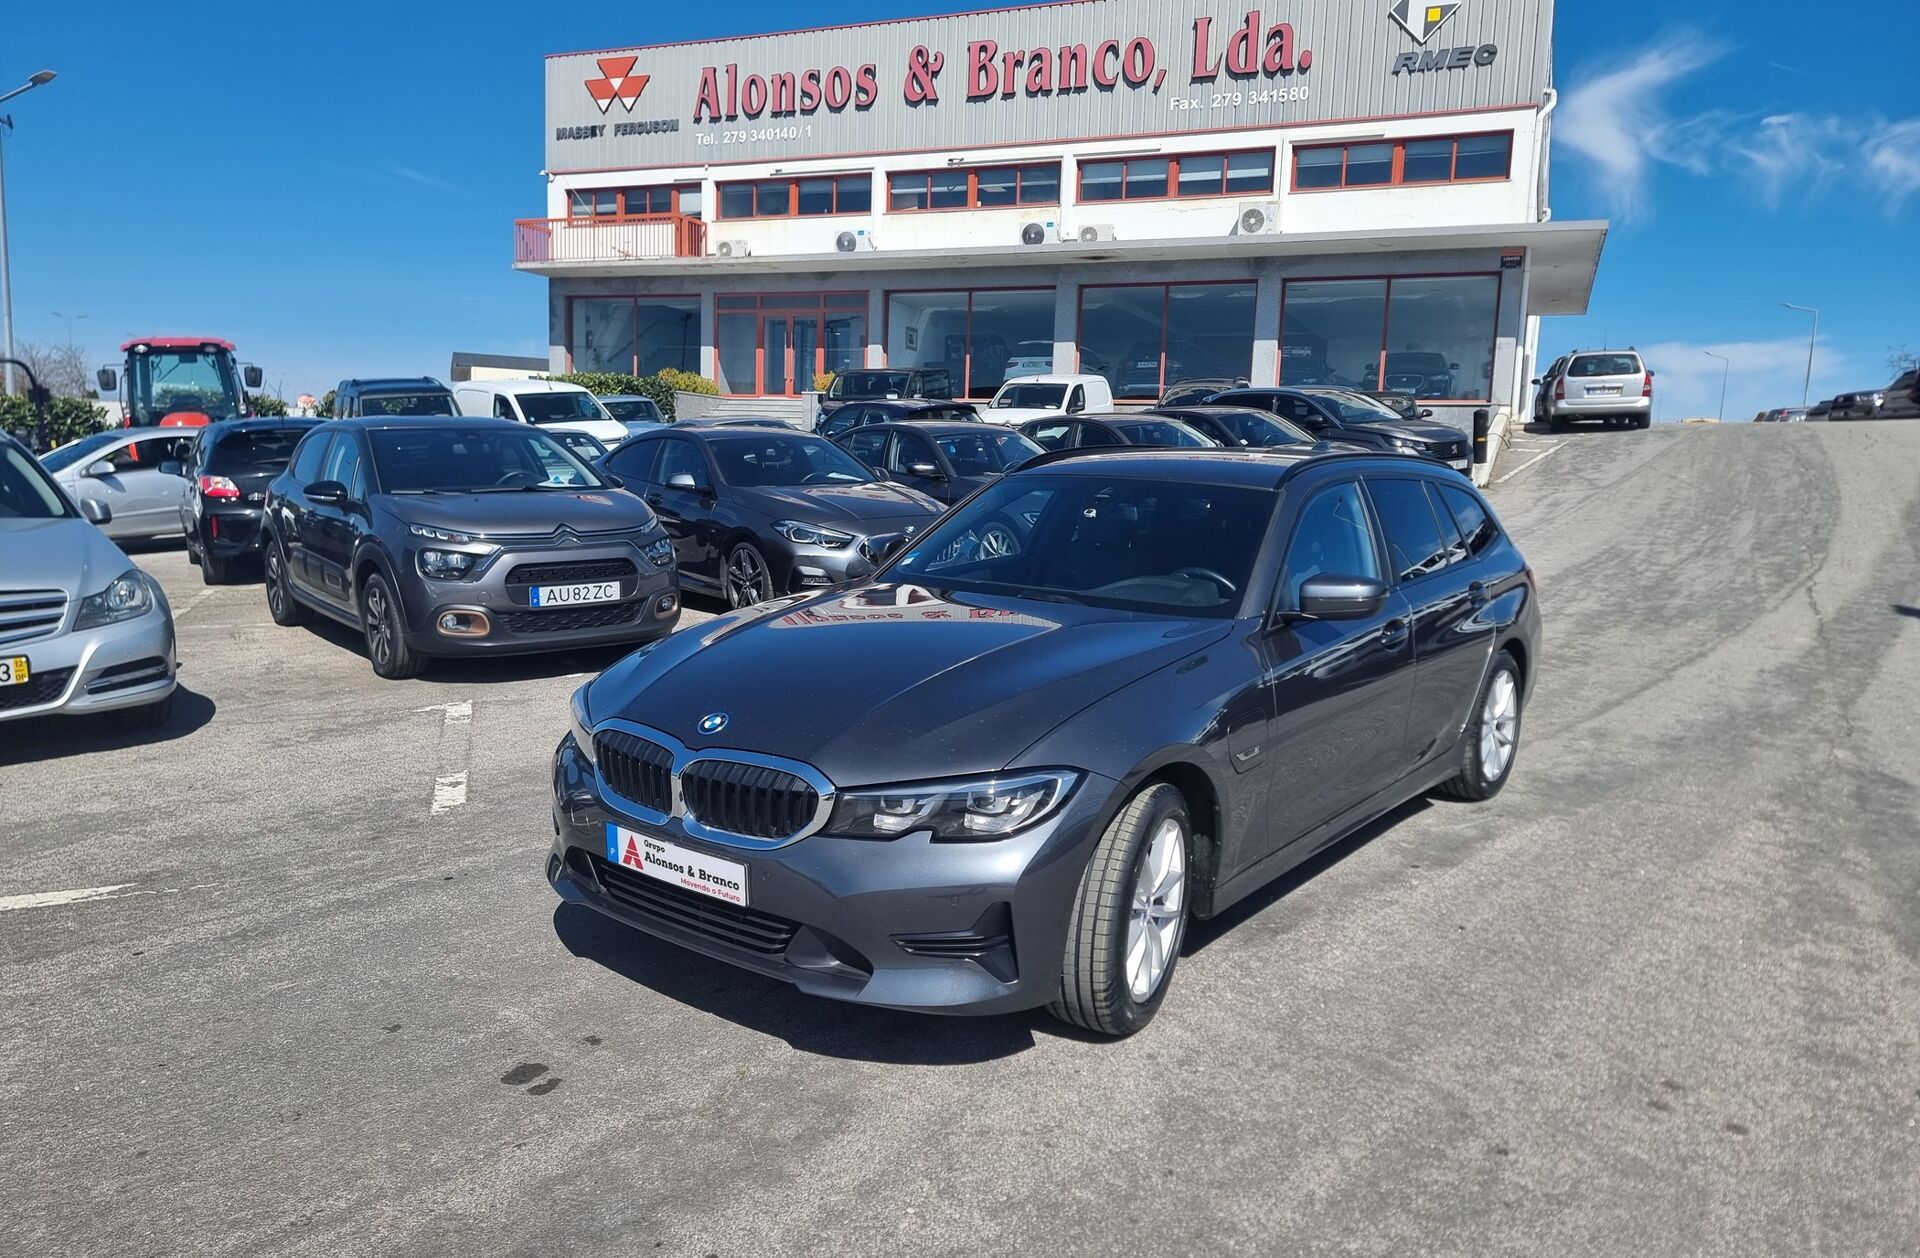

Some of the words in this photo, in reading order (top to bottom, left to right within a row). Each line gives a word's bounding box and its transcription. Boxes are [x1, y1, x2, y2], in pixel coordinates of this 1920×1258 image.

[693, 63, 878, 124] Alonsos
[904, 45, 944, 107] &
[966, 36, 1167, 103] Branco,
[1190, 10, 1312, 86] Lda.
[1170, 96, 1203, 110] Fax.
[1212, 92, 1242, 107] 279
[1248, 86, 1309, 104] 341580
[556, 124, 606, 141] MASSEY
[614, 119, 680, 137] FERGUSON
[695, 133, 718, 145] Tel.
[723, 131, 746, 144] 279
[546, 585, 613, 604] AU82ZC
[644, 839, 666, 853] Grupo
[644, 851, 684, 874] Alonsos
[687, 866, 695, 878] &
[698, 868, 740, 891] Branco
[680, 877, 711, 893] Movendo
[717, 889, 741, 902] Futuro
